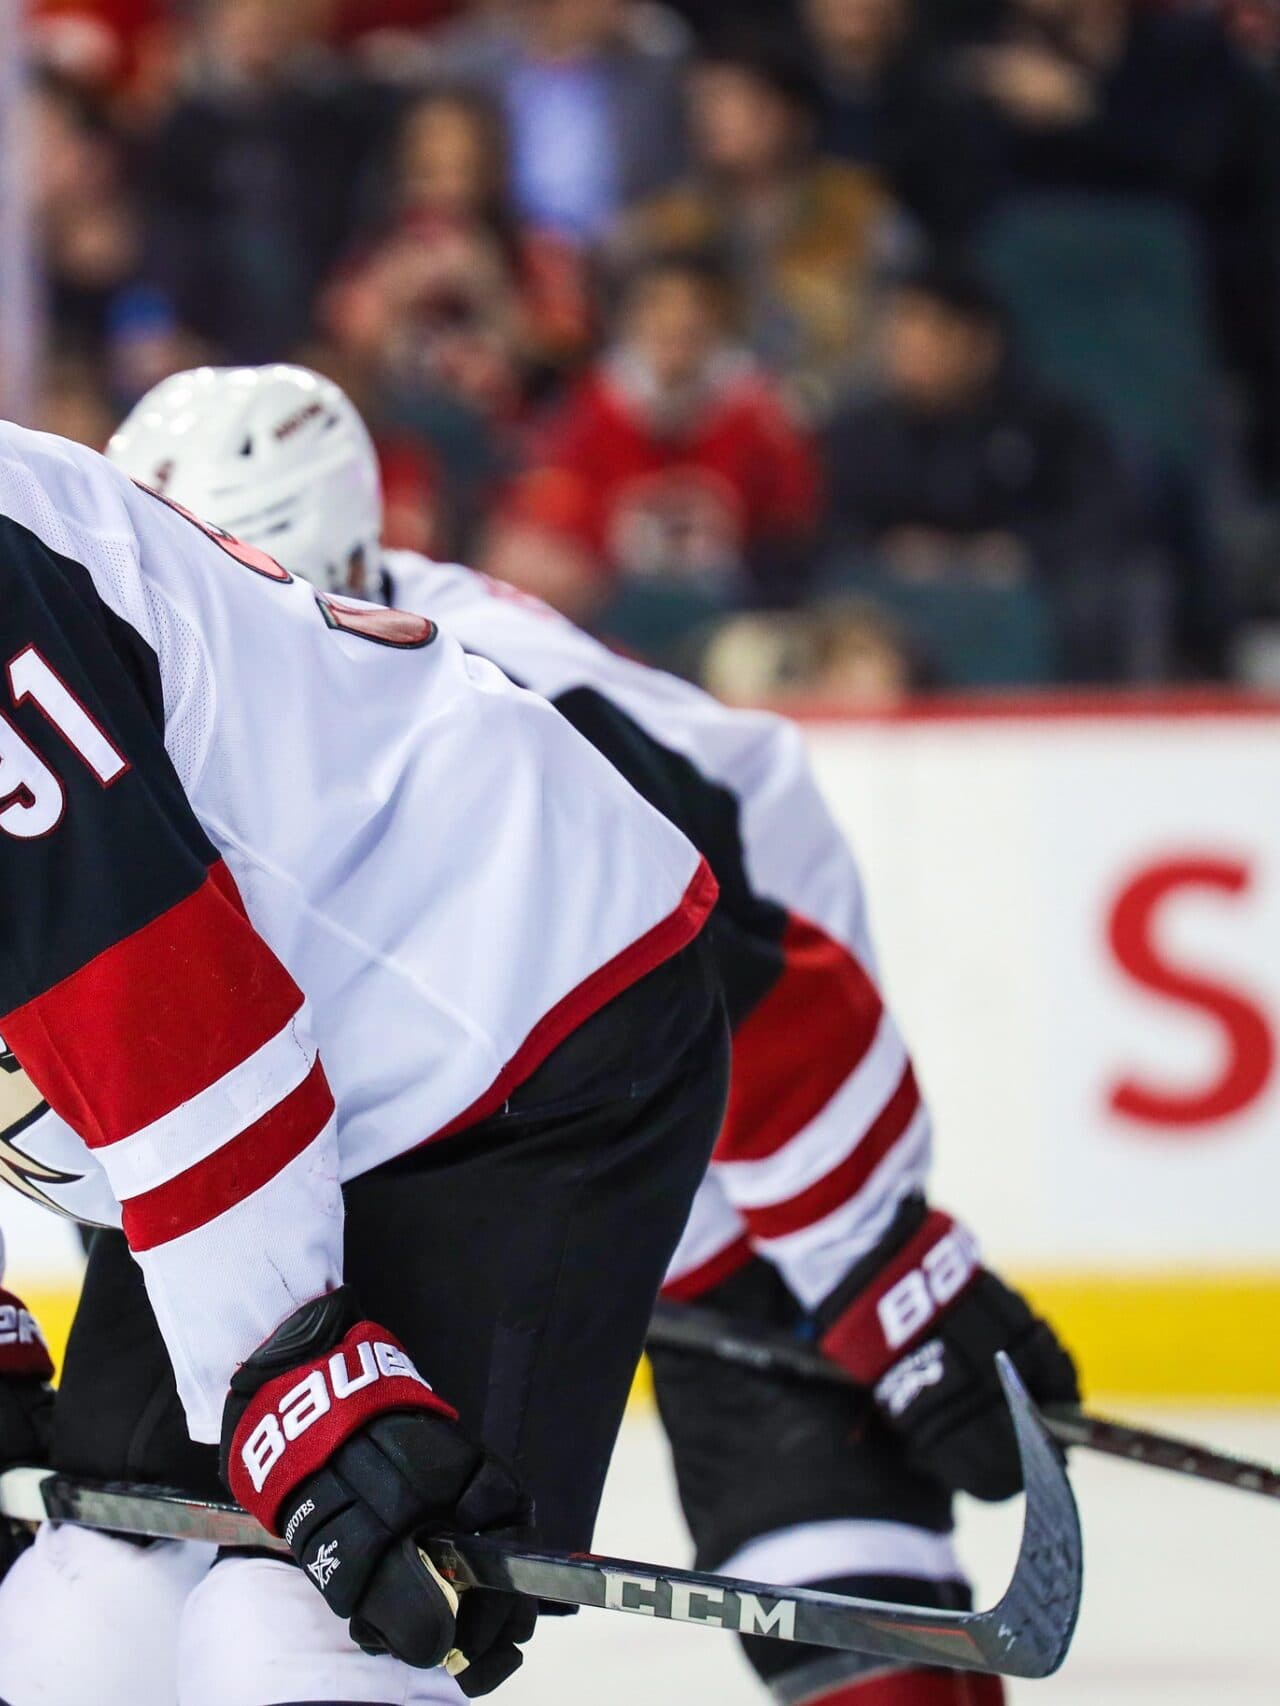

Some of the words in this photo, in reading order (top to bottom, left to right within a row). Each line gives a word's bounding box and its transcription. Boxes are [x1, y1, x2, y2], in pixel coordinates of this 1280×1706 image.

[1106, 857, 1277, 1129] S
[241, 1341, 433, 1493] BAUE
[600, 1568, 797, 1640] CCM
